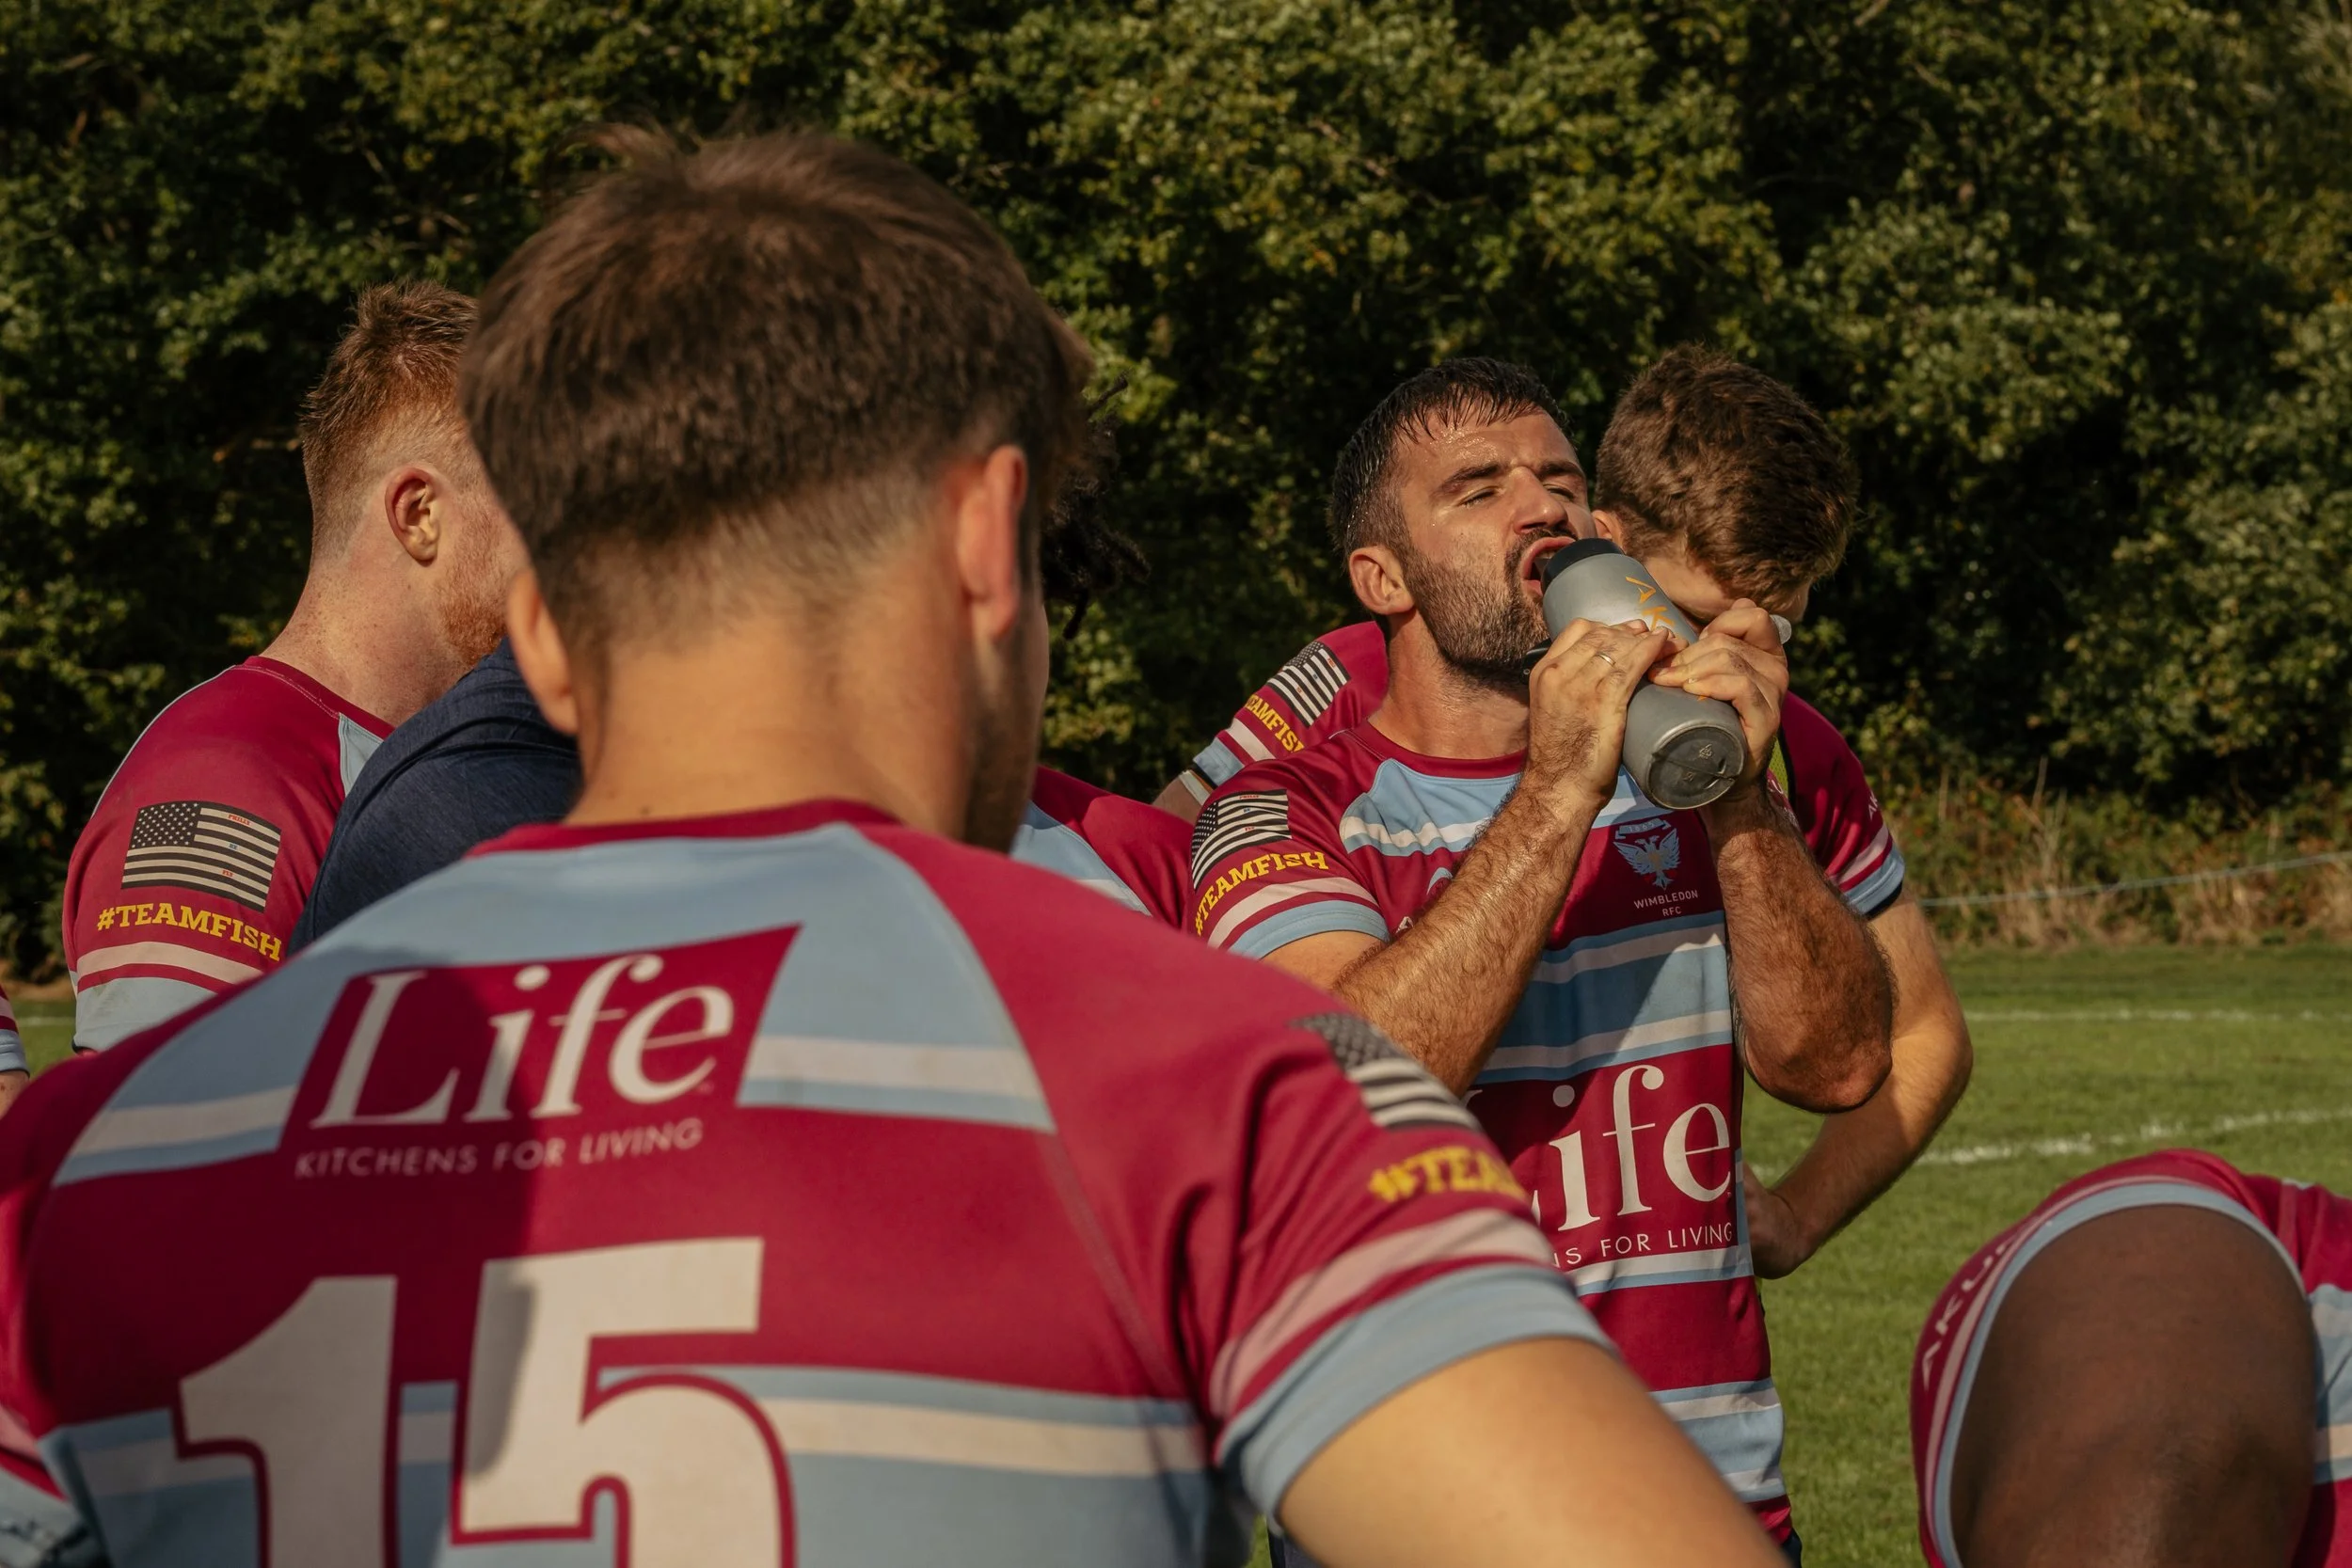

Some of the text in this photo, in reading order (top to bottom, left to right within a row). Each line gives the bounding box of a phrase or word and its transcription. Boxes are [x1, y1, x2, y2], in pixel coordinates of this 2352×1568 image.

[1195, 851, 1329, 937] #TEAMFISH
[1633, 890, 1699, 910] WIMBLEDON
[1661, 906, 1682, 917] RFC
[97, 902, 282, 962] #TEAMFISH
[309, 954, 735, 1129] Life
[294, 1117, 704, 1180] KITCHENS FOR LIVING
[1464, 1065, 1731, 1231] ife
[1600, 1222, 1733, 1258] FOR LIVING
[178, 1237, 786, 1568] 15
